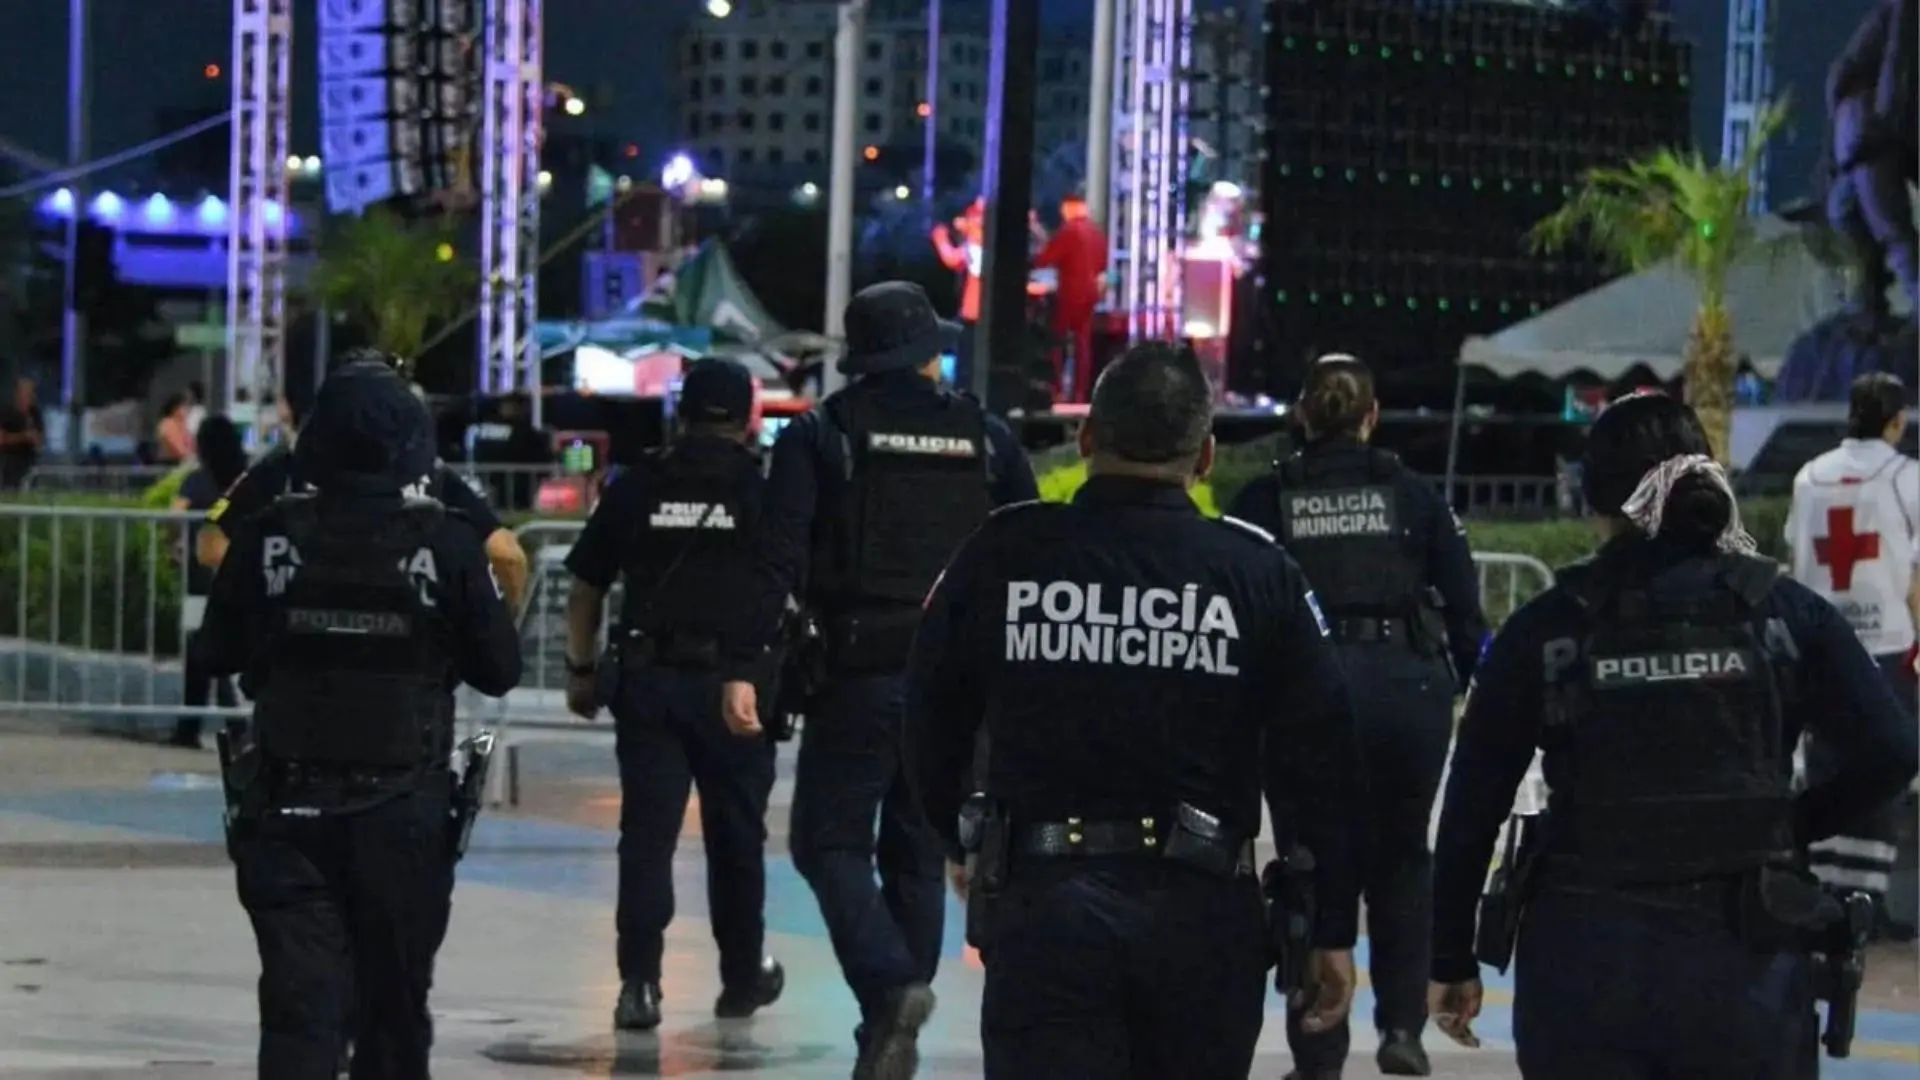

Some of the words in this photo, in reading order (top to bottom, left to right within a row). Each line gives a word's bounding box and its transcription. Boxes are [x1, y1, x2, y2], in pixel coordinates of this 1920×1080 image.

[871, 433, 974, 453] POLICIA
[1292, 488, 1385, 515] POLICÍA
[1292, 513, 1389, 538] MUNICIPAL
[288, 609, 409, 633] POLICIA
[1006, 580, 1240, 640] POLICÍA
[1005, 622, 1240, 676] MUNICIPAL
[1596, 651, 1746, 681] POLICIA
